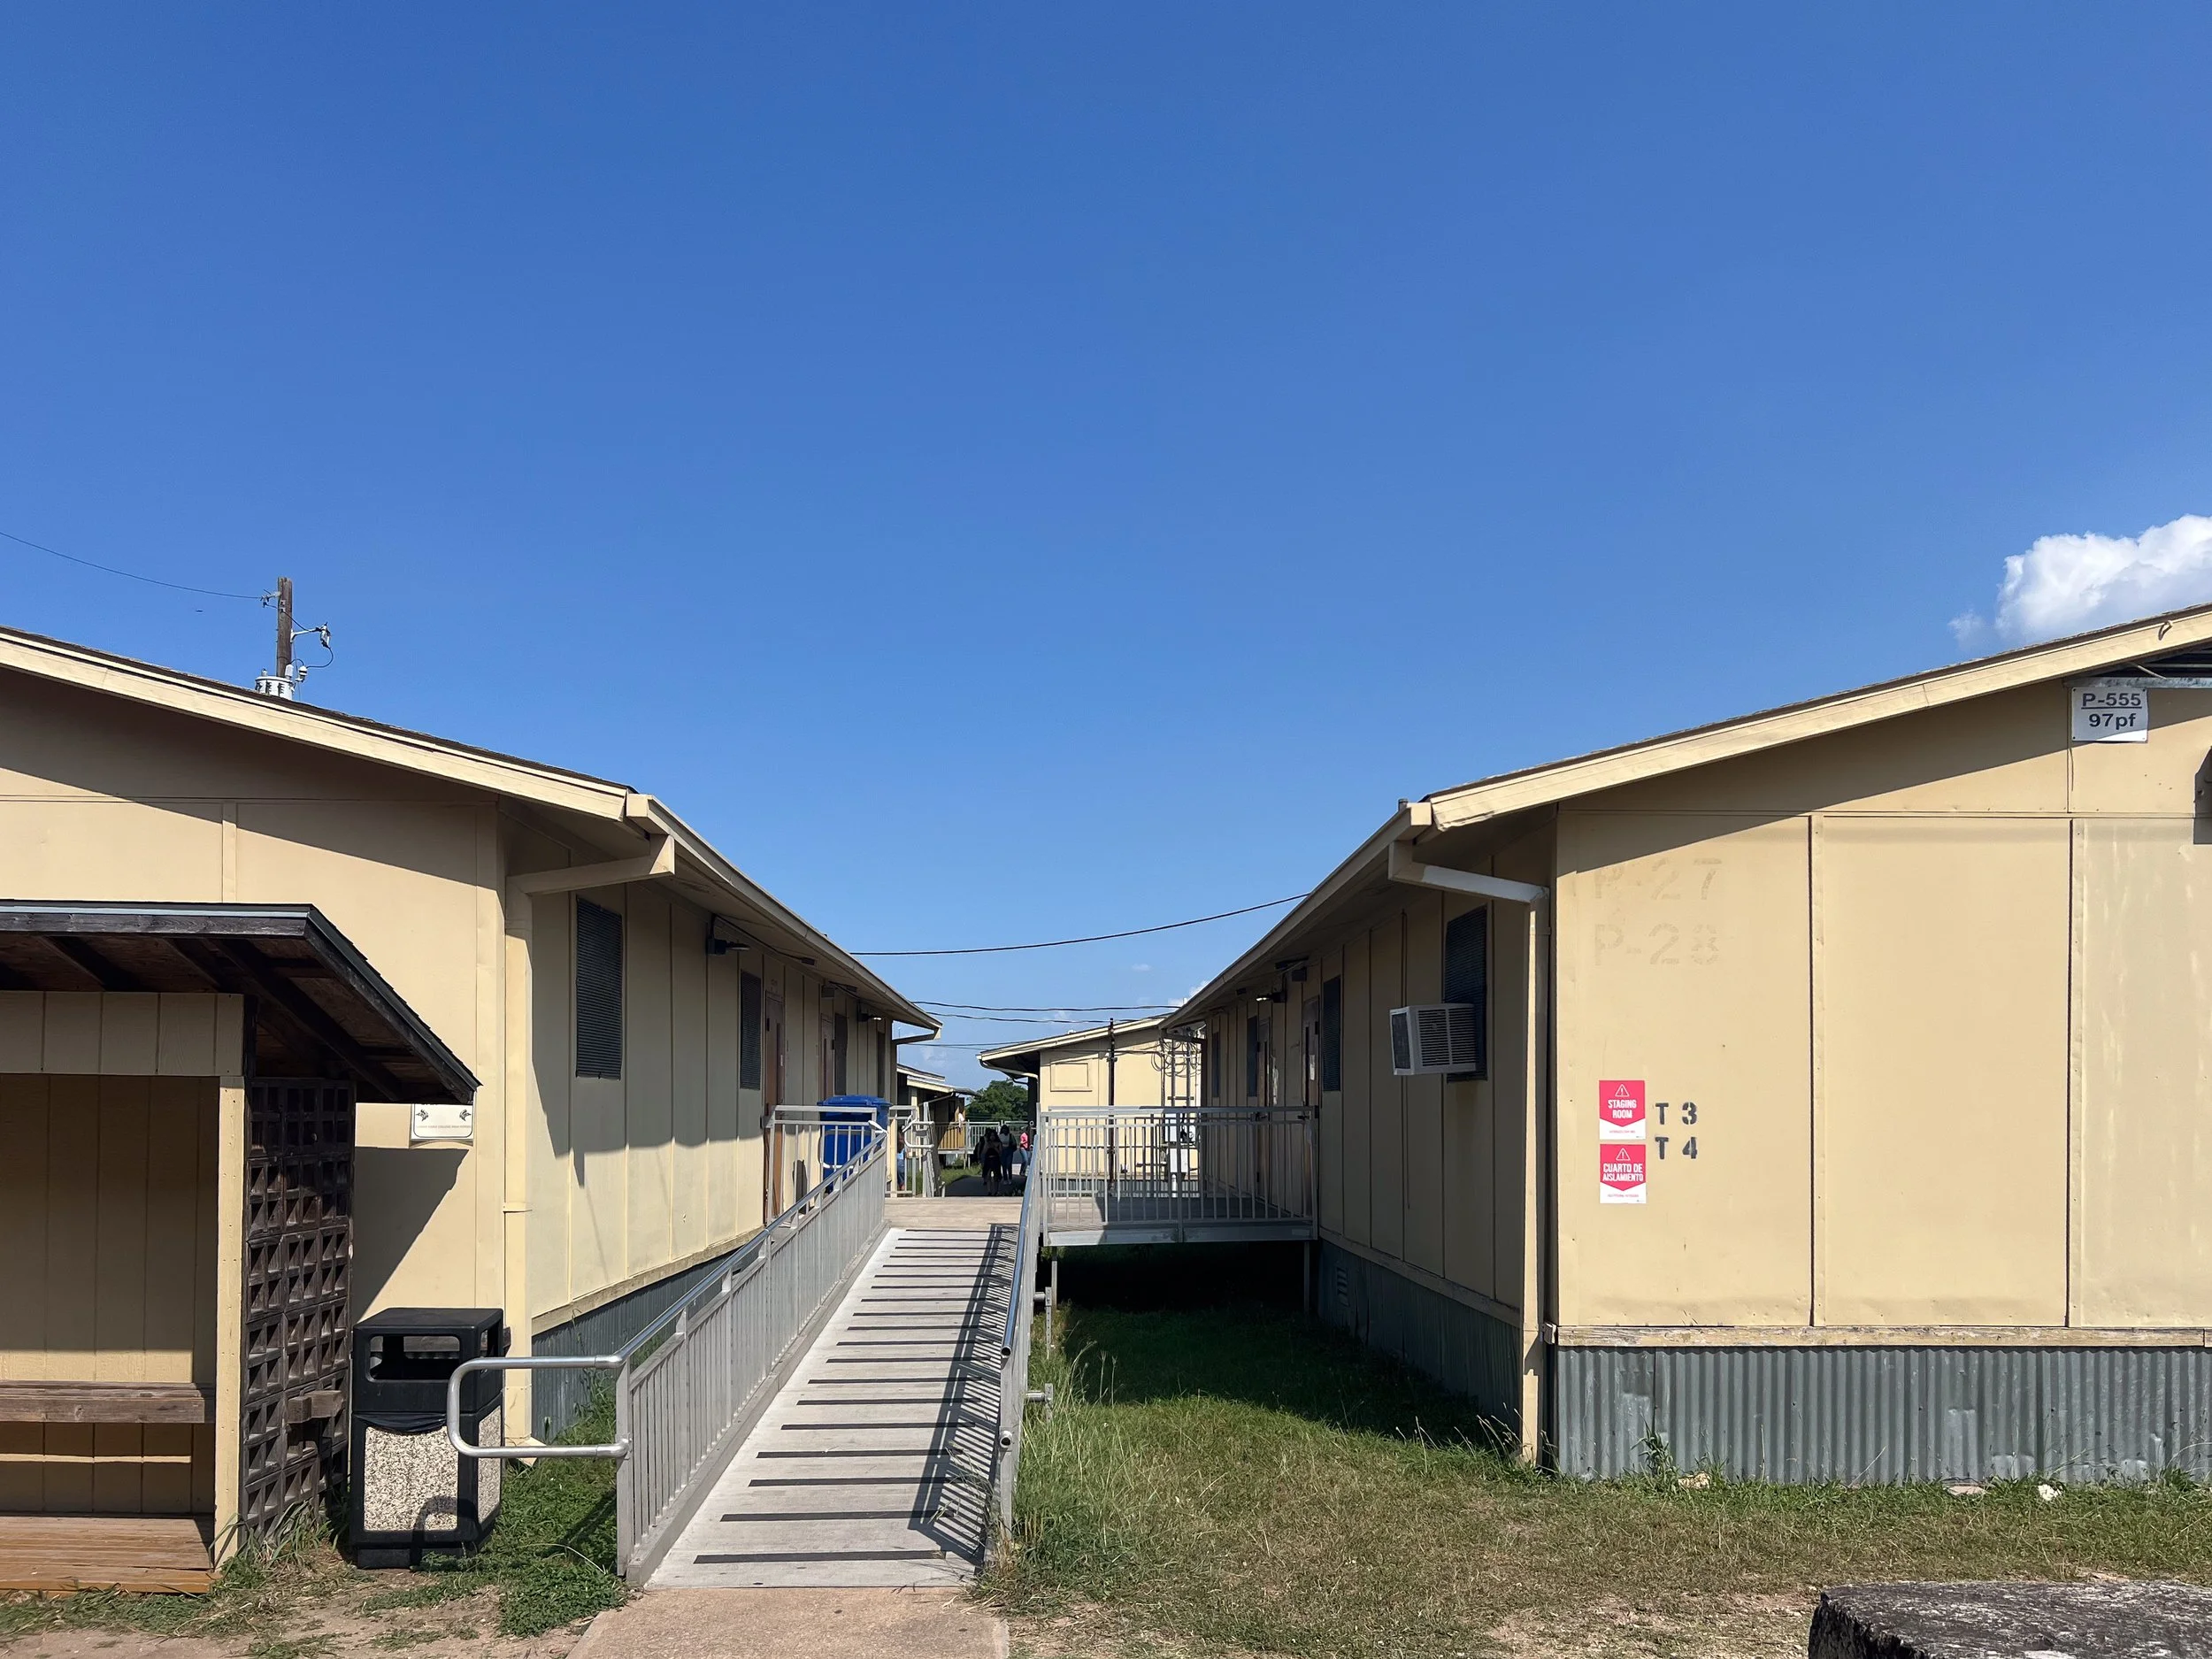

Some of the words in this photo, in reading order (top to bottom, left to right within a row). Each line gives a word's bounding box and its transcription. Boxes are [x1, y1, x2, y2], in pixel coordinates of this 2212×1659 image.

[2082, 693, 2142, 707] P-555
[2088, 712, 2137, 731] 97pf
[1608, 1099, 1638, 1110] STAGING
[1612, 1110, 1633, 1119] ROOM
[1602, 1163, 1632, 1173] CUARTO
[1633, 1163, 1643, 1173] DE
[1602, 1172, 1644, 1182] AISLAMIENTO
